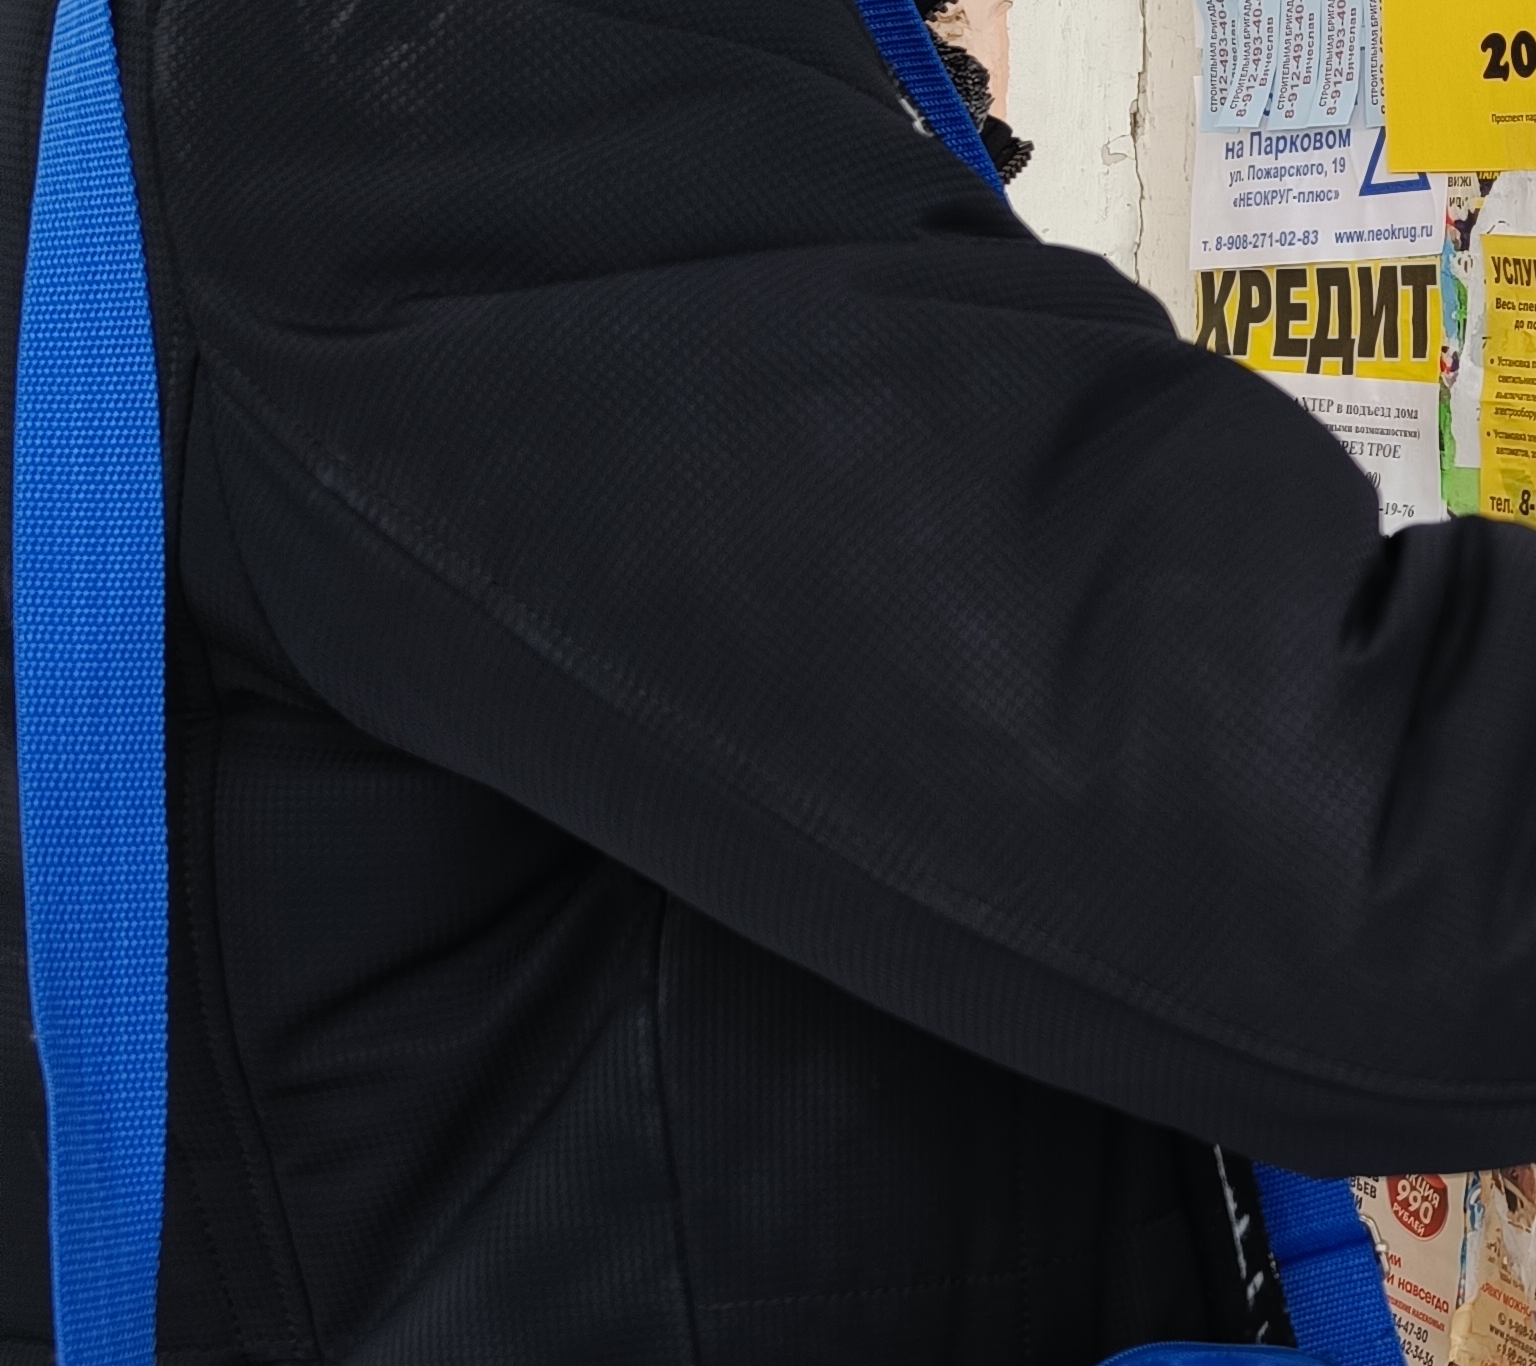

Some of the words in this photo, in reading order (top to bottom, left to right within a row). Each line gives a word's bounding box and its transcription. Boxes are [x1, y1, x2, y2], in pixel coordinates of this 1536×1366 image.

[1225, 141, 1244, 160] на
[1249, 128, 1351, 160] Парковом
[1229, 170, 1243, 187] ул.
[1247, 160, 1329, 185] Пожарского,
[1332, 158, 1346, 174] 19
[1202, 240, 1211, 252] т.
[1215, 230, 1318, 251] 8-908-271-02-83
[1335, 223, 1432, 244] www.neokrug.ru
[1200, 264, 1438, 375] КРЕДИТ
[1490, 495, 1514, 515] тел.
[1397, 1179, 1434, 1225] 990
[1392, 1202, 1425, 1237] РУБЛЕЙ
[1398, 1277, 1449, 1314] навсегда
